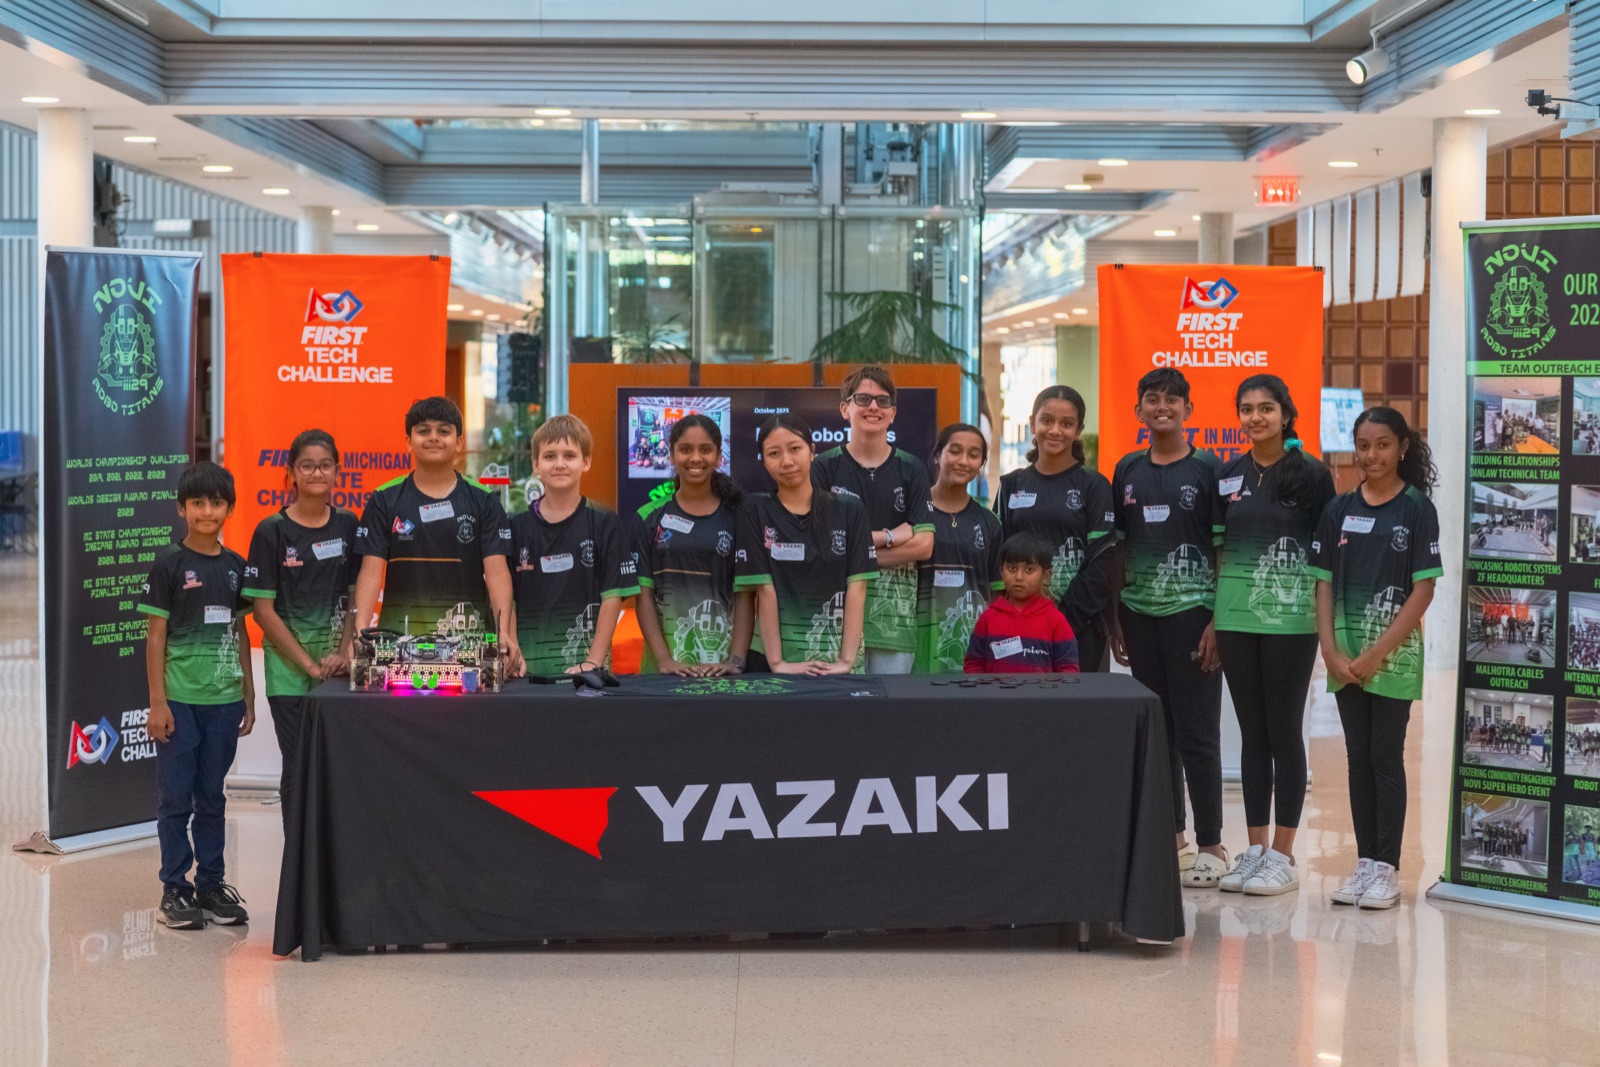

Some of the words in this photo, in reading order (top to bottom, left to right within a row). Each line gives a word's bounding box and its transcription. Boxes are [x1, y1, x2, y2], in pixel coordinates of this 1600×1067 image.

[1564, 273, 1598, 296] OUR
[1176, 313, 1243, 331] FIRST
[301, 326, 368, 345] FIRST
[1181, 333, 1233, 349] TECH
[305, 348, 357, 364] TECH
[1152, 351, 1268, 368] CHALLENGE
[277, 366, 393, 383] CHALLENGE
[1500, 364, 1530, 374] TEAM
[1533, 363, 1592, 374] OUTREACH
[1205, 428, 1218, 444] IN
[67, 458, 92, 469] WORLDS
[96, 456, 147, 467] CHAMPIONSHIP
[150, 454, 189, 466] QUALIFIER
[258, 450, 289, 466] FIR
[344, 453, 411, 469] MICHIGAN
[1470, 455, 1502, 465] BUILDING
[1504, 456, 1560, 467] RELATIONSHIPS
[147, 470, 165, 479] 2023
[1470, 468, 1498, 478] DANLAW
[1499, 468, 1538, 479] TECHNICAL
[1540, 470, 1560, 480] TEAM
[68, 495, 93, 505] WORLDS
[97, 494, 121, 504] DESIGN
[124, 492, 148, 502] AWARD
[152, 490, 178, 500] FINALI
[117, 508, 134, 517] 2023
[83, 532, 92, 541] MI
[95, 530, 115, 540] STATE
[118, 526, 172, 538] CHAMPIONSHIP
[356, 527, 368, 538] 29
[116, 539, 139, 549] AWARD
[142, 537, 170, 547] WINNER
[138, 552, 155, 562] 2022
[244, 566, 258, 577] 29
[1465, 560, 1503, 572] SHOWCASING
[1504, 562, 1532, 573] ROBOTIC
[1533, 564, 1562, 575] SYSTEMS
[83, 579, 92, 588] MI
[95, 577, 115, 587] STATE
[1478, 572, 1486, 582] ZF
[1487, 573, 1544, 585] HEADQUARTERS
[91, 586, 124, 598] FINALIST
[83, 626, 93, 636] MI
[96, 623, 116, 634] STATE
[119, 620, 149, 631] CHAMPIO
[93, 633, 122, 645] WINNING
[126, 630, 148, 640] ALLIA
[1023, 644, 1049, 656] pion
[1476, 664, 1516, 676] MALHOTRA
[1517, 667, 1544, 679] CABLES
[1490, 677, 1529, 689] OUTREACH
[121, 708, 150, 727] FIRS
[121, 742, 157, 762] CHALL
[1460, 766, 1487, 778] FOSTERING
[1488, 769, 1520, 782] COMMUNITY
[1521, 773, 1557, 786] ENGAGEMENT
[1464, 778, 1481, 788] NOVI
[1482, 780, 1505, 792] SUPER
[1507, 783, 1526, 794] HERO
[1528, 785, 1551, 797] EVENT
[1574, 780, 1599, 791] ROBOT
[634, 772, 1009, 842] YAZAKI
[1461, 870, 1479, 883] LEARN
[1480, 874, 1508, 886] ROBOTICS
[1509, 877, 1548, 892] ENGINEERING
